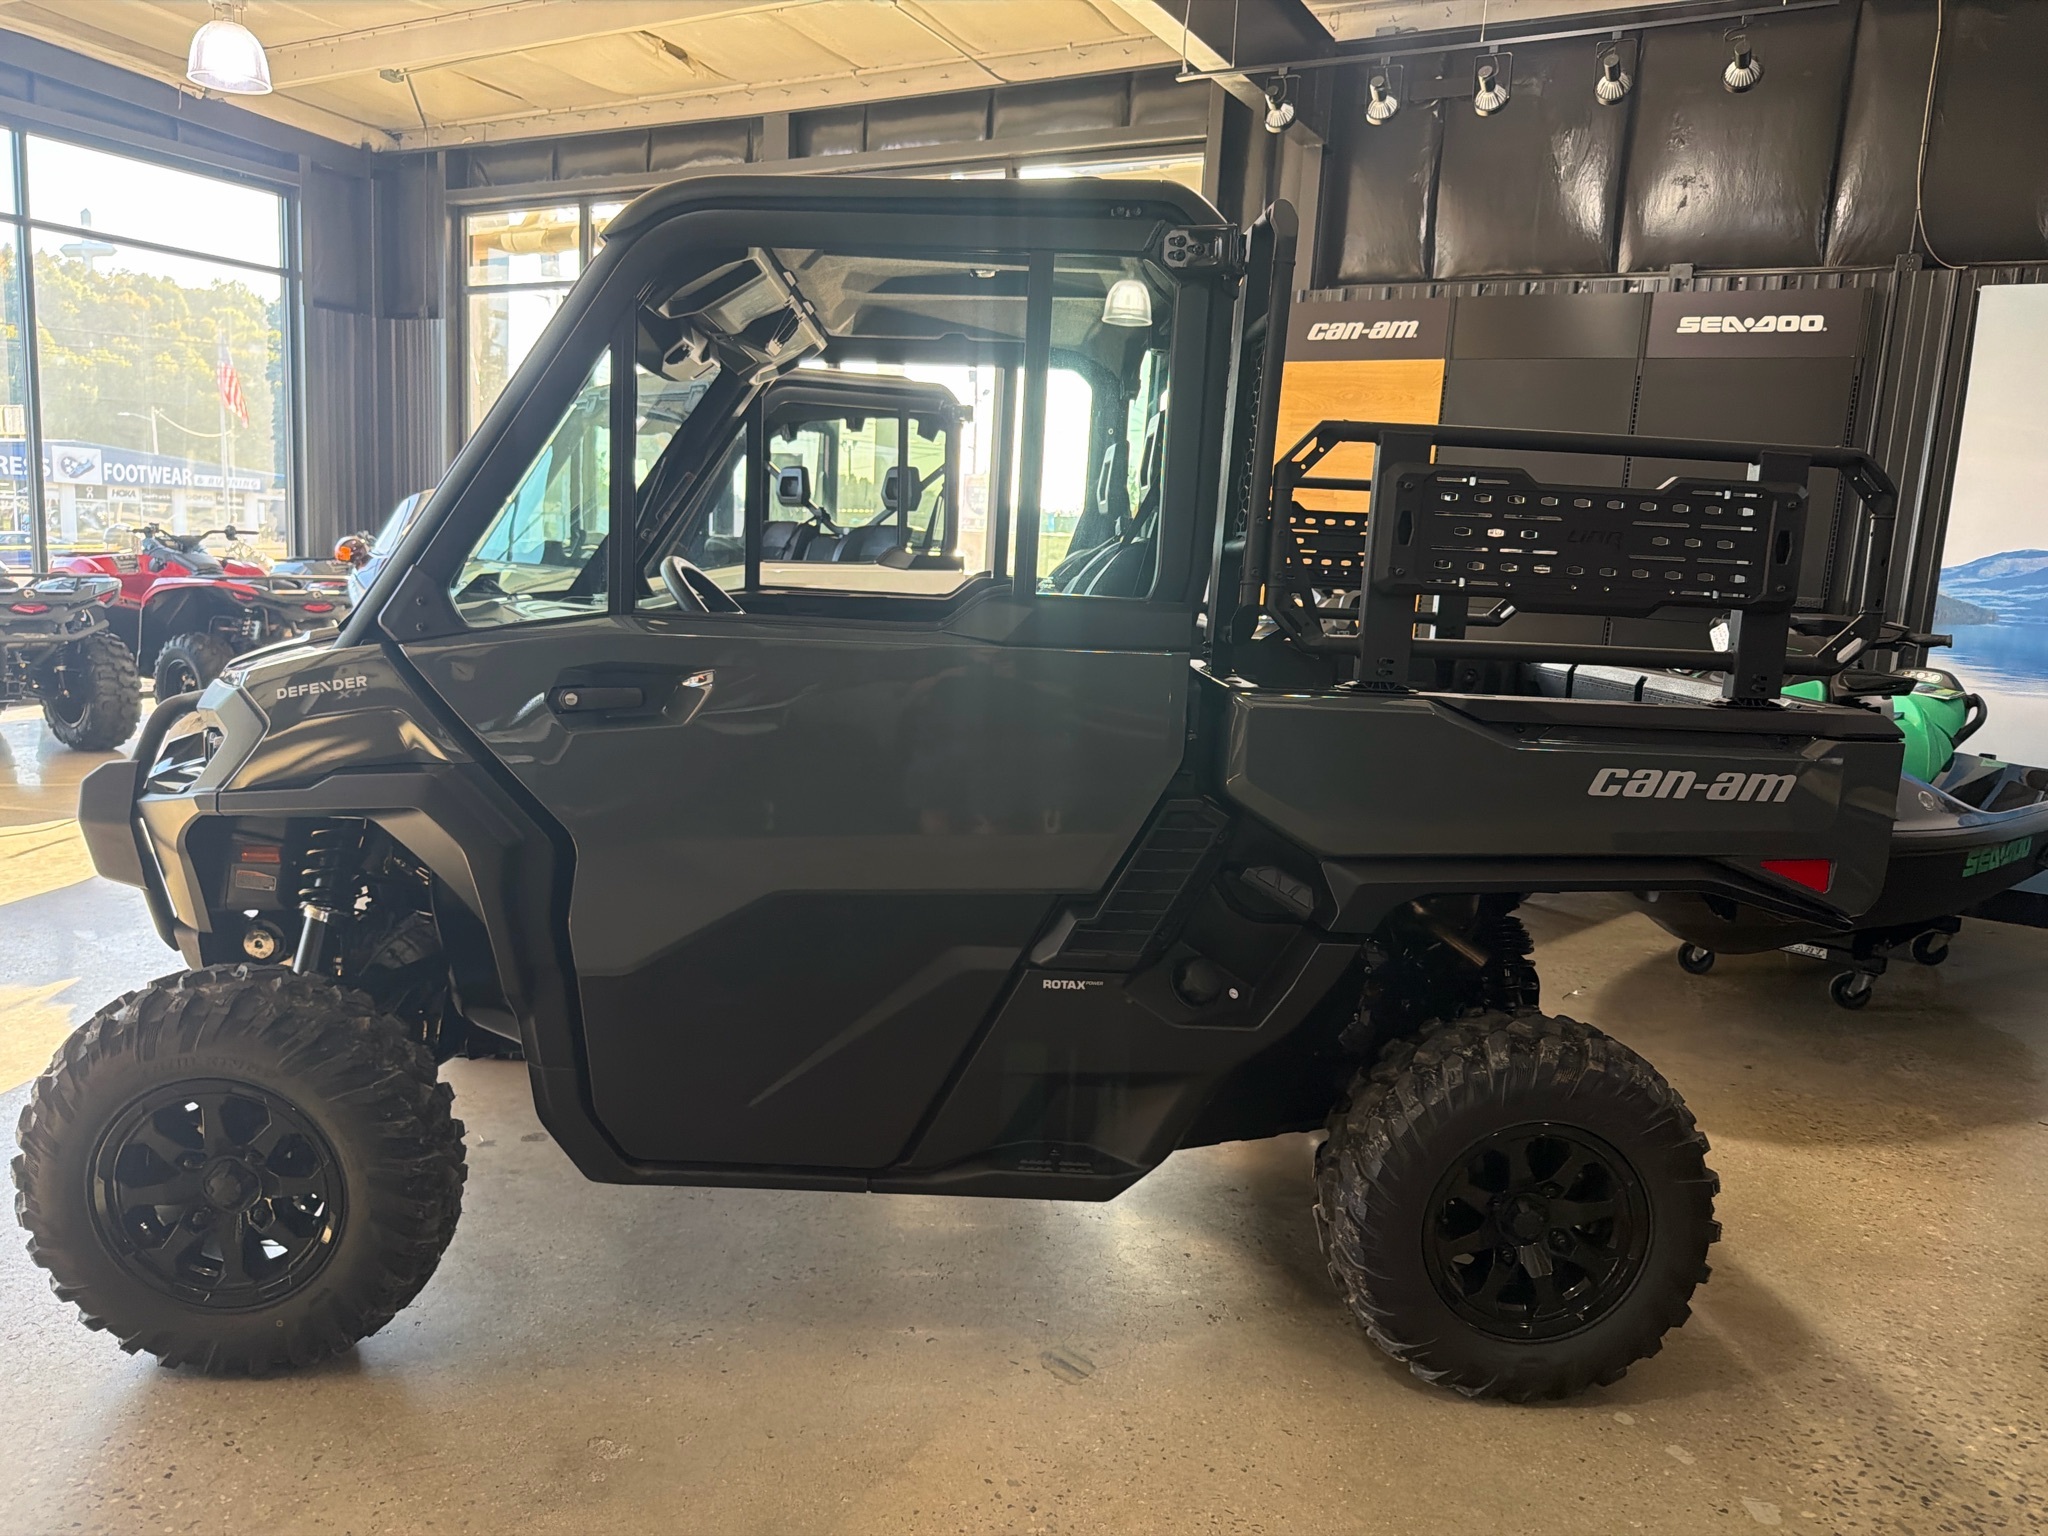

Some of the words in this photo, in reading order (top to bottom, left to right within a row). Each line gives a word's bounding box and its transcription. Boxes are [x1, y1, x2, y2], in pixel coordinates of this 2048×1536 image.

[0, 455, 51, 477] RES
[103, 462, 192, 486] FOOTWEAR
[208, 477, 258, 488] RUNING
[111, 489, 136, 498] HOKA
[276, 675, 367, 700] DEFENDER
[336, 688, 367, 700] XT
[1587, 768, 1797, 803] can-am
[1043, 979, 1086, 990] ROTAX
